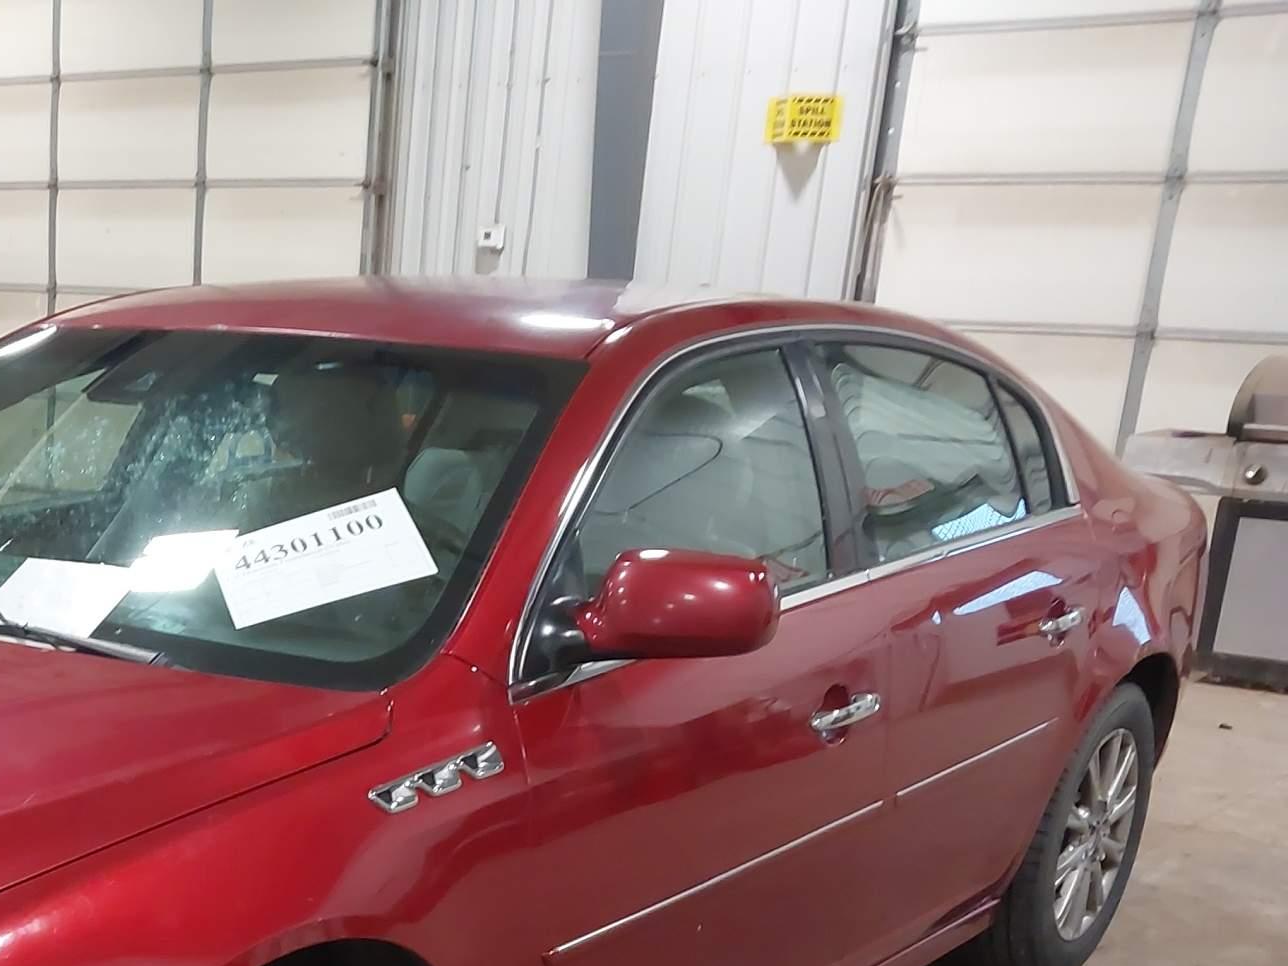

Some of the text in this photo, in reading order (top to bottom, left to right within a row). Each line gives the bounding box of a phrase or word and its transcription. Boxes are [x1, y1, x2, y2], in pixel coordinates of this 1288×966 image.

[799, 106, 824, 115] SPILL
[791, 119, 831, 128] STATION
[234, 513, 384, 571] 44301100
